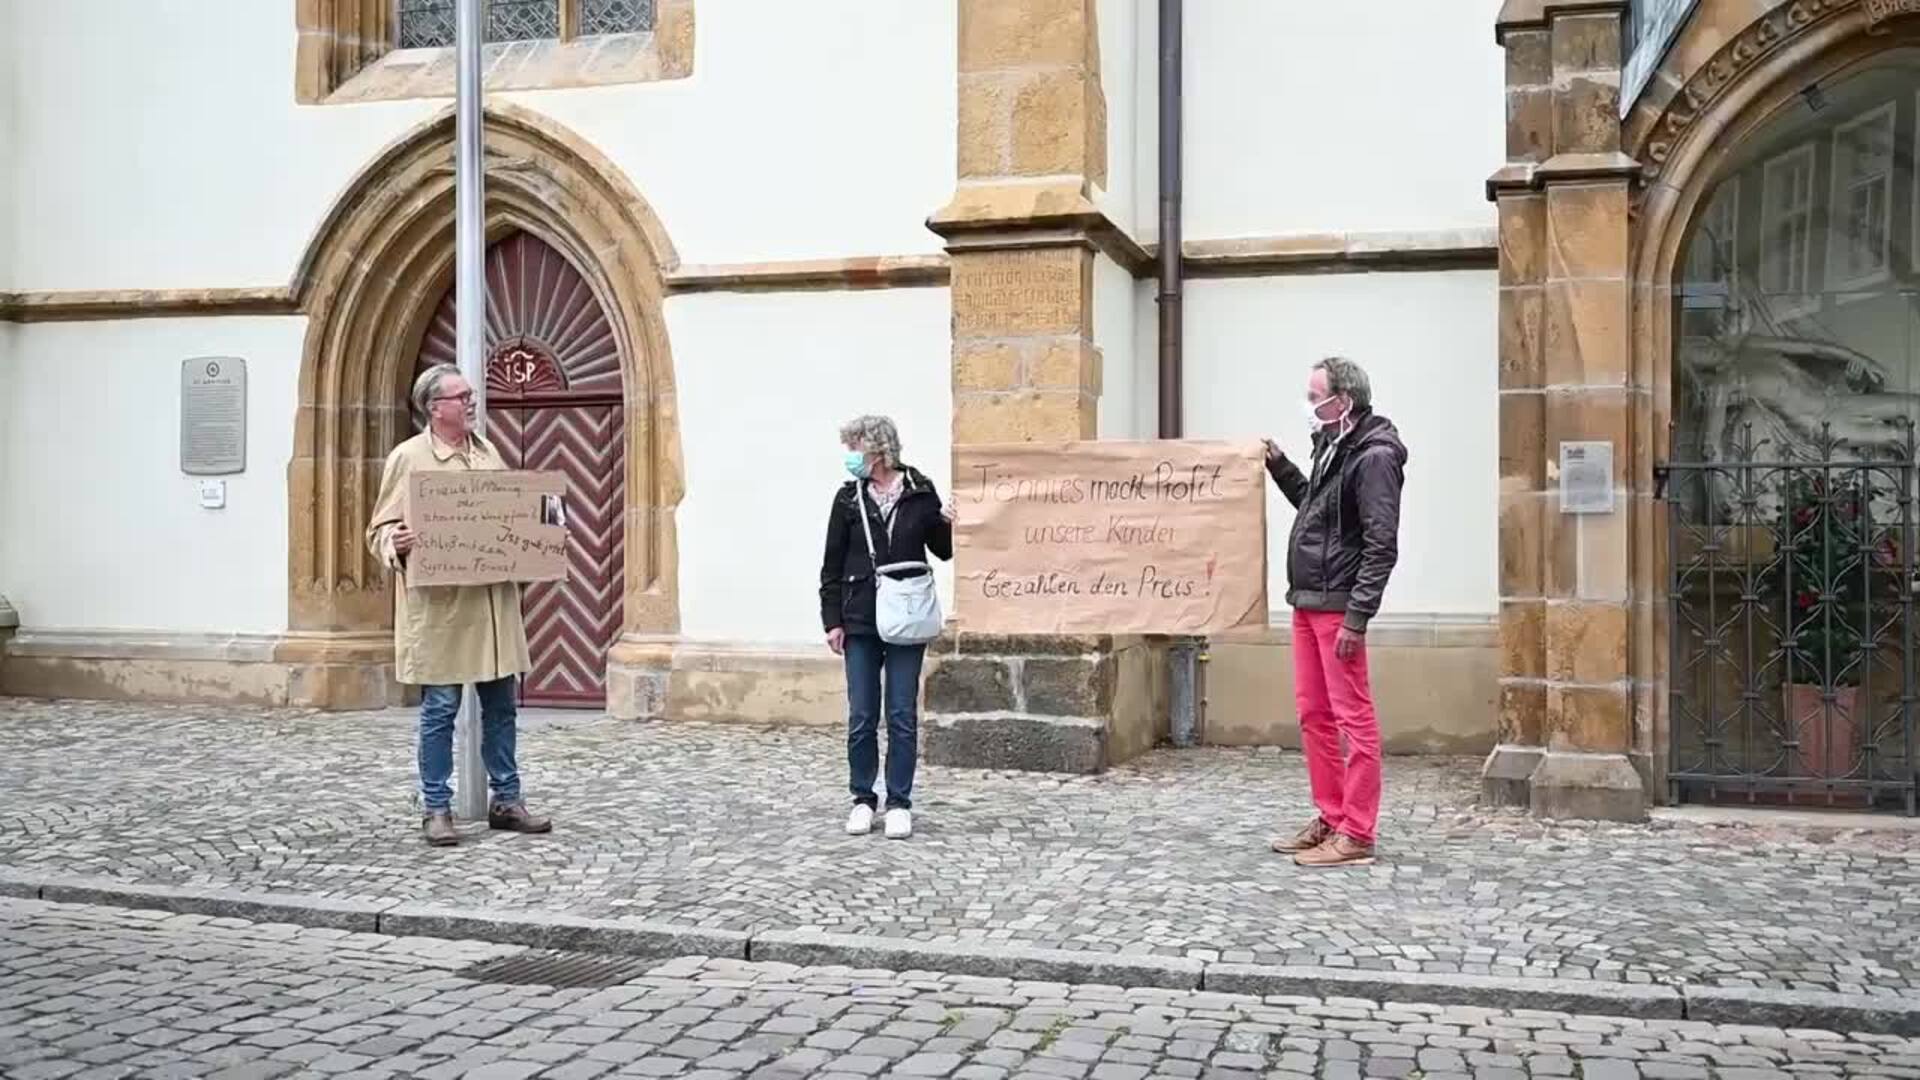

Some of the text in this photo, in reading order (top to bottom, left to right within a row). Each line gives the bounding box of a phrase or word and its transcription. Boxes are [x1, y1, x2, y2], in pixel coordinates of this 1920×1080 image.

[1090, 474, 1146, 501] macht
[1154, 460, 1223, 503] Profit
[1024, 515, 1177, 546] unsere Kinder
[1089, 573, 1129, 596] den
